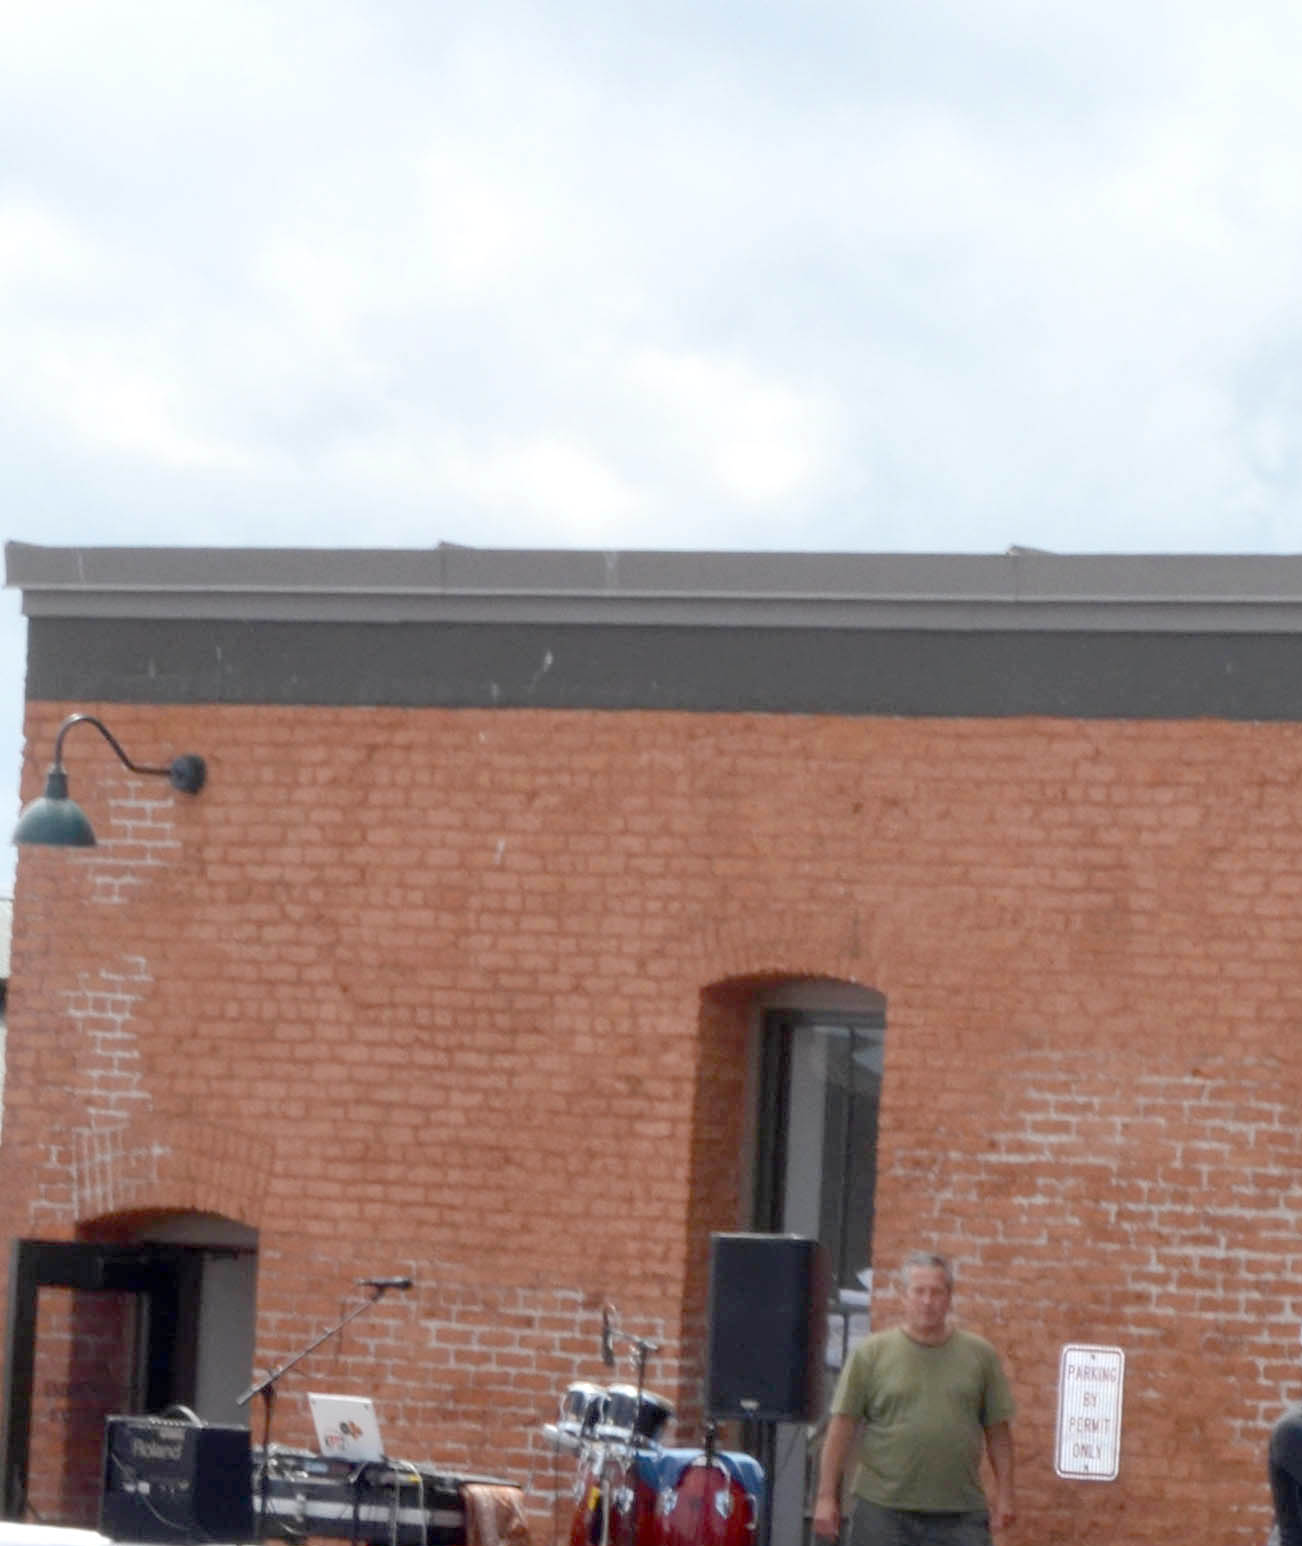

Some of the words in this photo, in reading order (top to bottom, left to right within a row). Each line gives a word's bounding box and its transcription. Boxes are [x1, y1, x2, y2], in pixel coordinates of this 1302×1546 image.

[1068, 1364, 1117, 1382] PARKING
[1082, 1392, 1097, 1408] BY
[1069, 1417, 1111, 1434] PERMIT
[1072, 1443, 1103, 1460] ONLY
